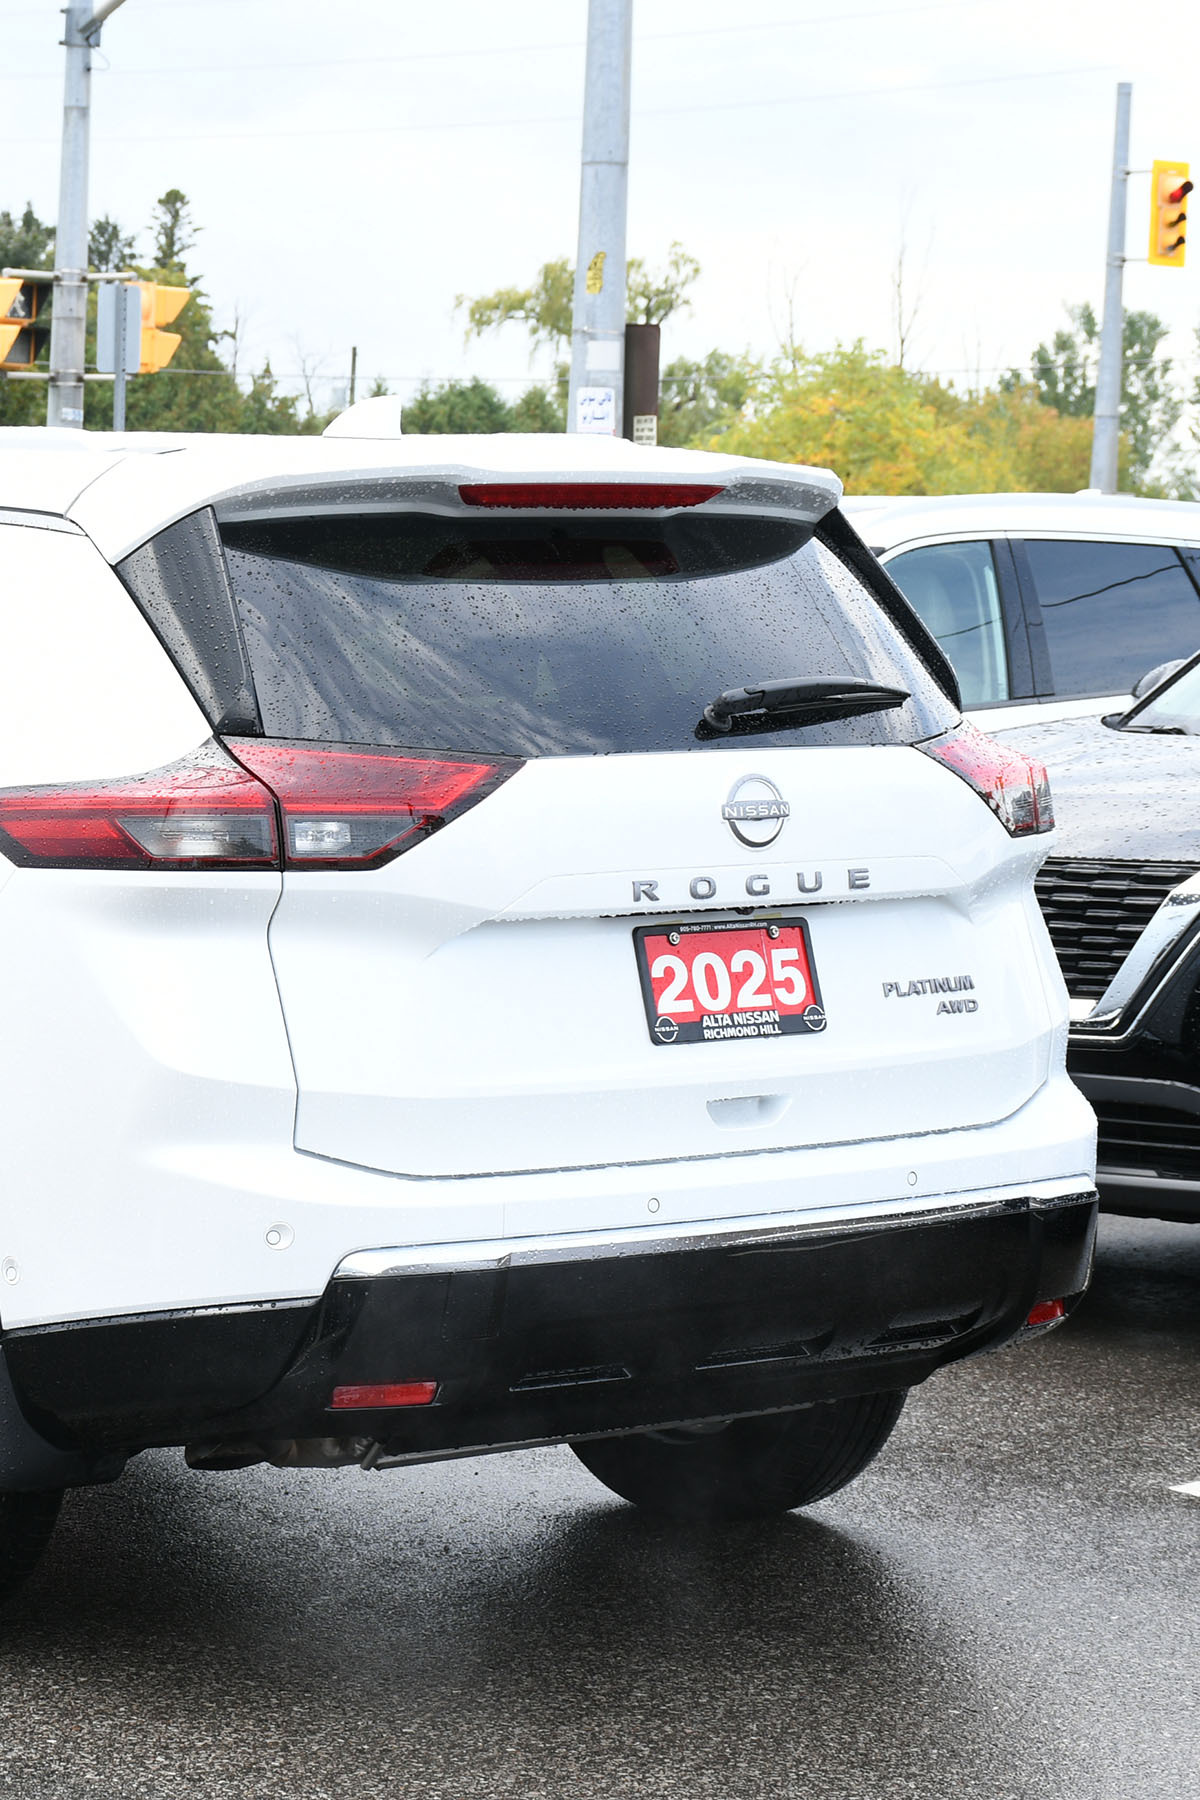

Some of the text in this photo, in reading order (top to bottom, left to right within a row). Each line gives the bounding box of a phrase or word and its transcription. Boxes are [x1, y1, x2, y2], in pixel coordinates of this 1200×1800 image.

[724, 804, 789, 817] NISSAN
[632, 867, 871, 903] ROGUE
[651, 948, 807, 1014] 2025
[882, 975, 976, 998] PLATINUM
[936, 999, 979, 1015] AWD
[702, 1010, 780, 1027] ALTA NISSAN
[802, 1013, 826, 1021] NISSAN
[703, 1024, 782, 1040] RICHMOND HILL
